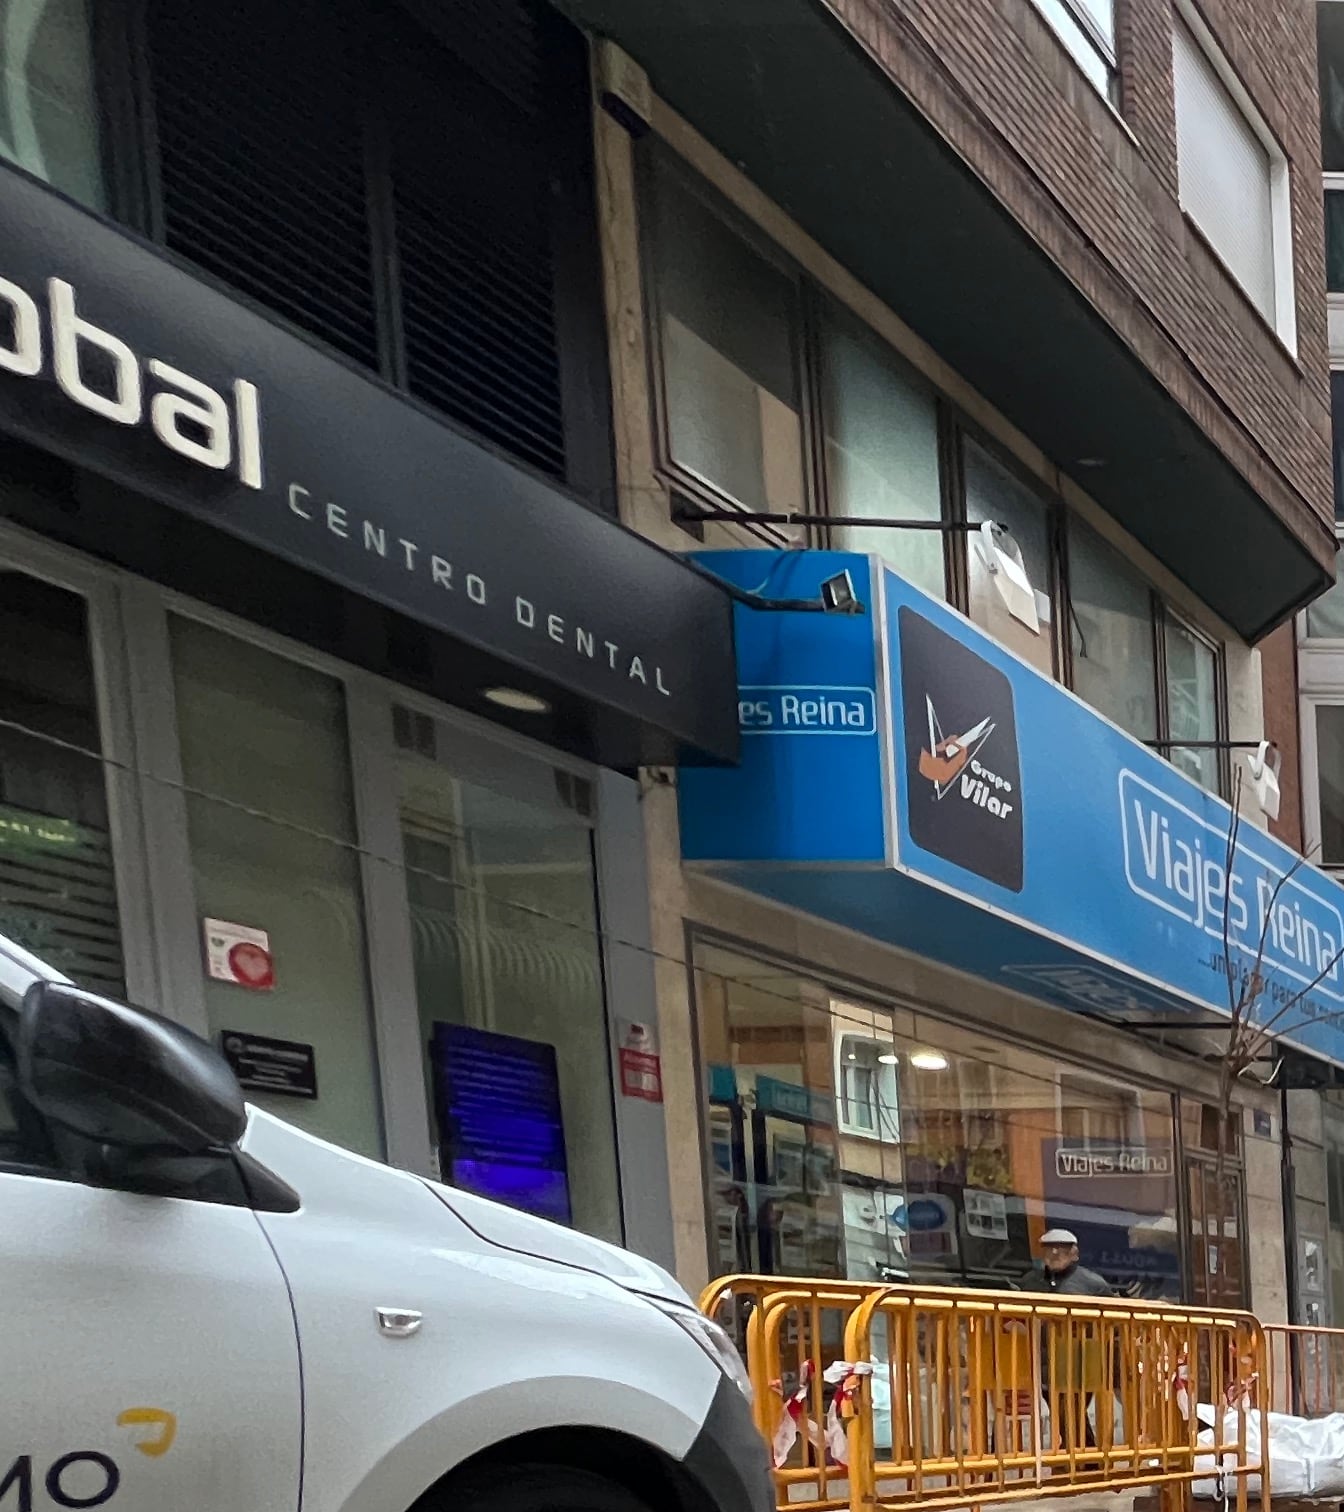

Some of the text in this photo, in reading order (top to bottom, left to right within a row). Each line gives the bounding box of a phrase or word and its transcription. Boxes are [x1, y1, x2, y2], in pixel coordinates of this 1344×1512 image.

[287, 482, 672, 697] CENTRO DENTAL
[780, 694, 866, 727] Reina
[970, 759, 1012, 793] Grupo
[960, 773, 1014, 820] Vilar
[1134, 798, 1339, 983] Viajes Reina
[1061, 1153, 1115, 1178] Viajes
